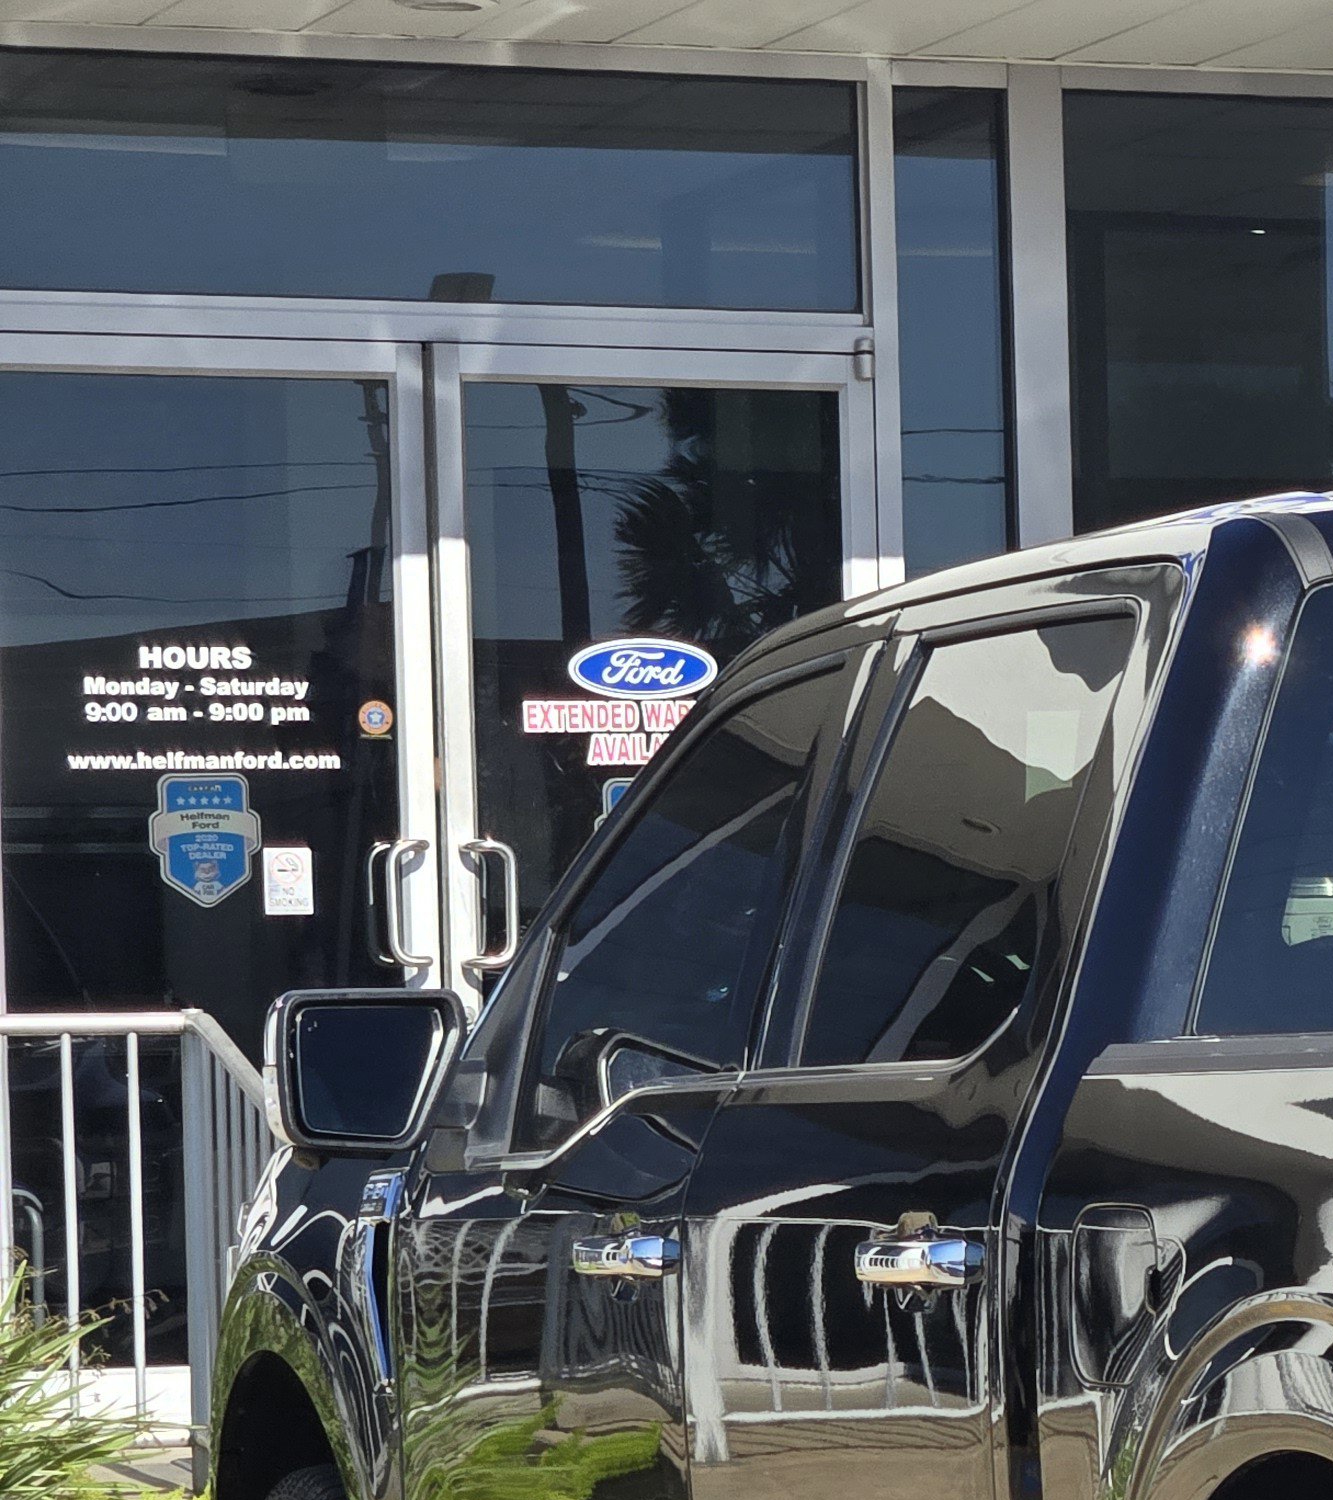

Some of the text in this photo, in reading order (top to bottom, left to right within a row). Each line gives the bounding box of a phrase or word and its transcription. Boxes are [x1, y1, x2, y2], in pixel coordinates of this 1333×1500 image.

[138, 646, 252, 669] HOURS
[602, 650, 687, 685] Ford
[83, 676, 179, 700] Monday
[199, 676, 309, 700] Saturday
[84, 702, 138, 722] 9:00
[147, 705, 187, 721] am
[208, 702, 264, 722] 9:00
[270, 705, 310, 726] pm
[526, 703, 637, 729] EXTENDED
[67, 750, 341, 770] www.helfmanford.com
[180, 811, 230, 822] Helfman
[191, 821, 220, 830] Ford
[180, 843, 234, 853] TOP-RATED
[188, 851, 227, 860] DEALER
[281, 886, 295, 896] NO
[269, 898, 309, 907] SMOKING
